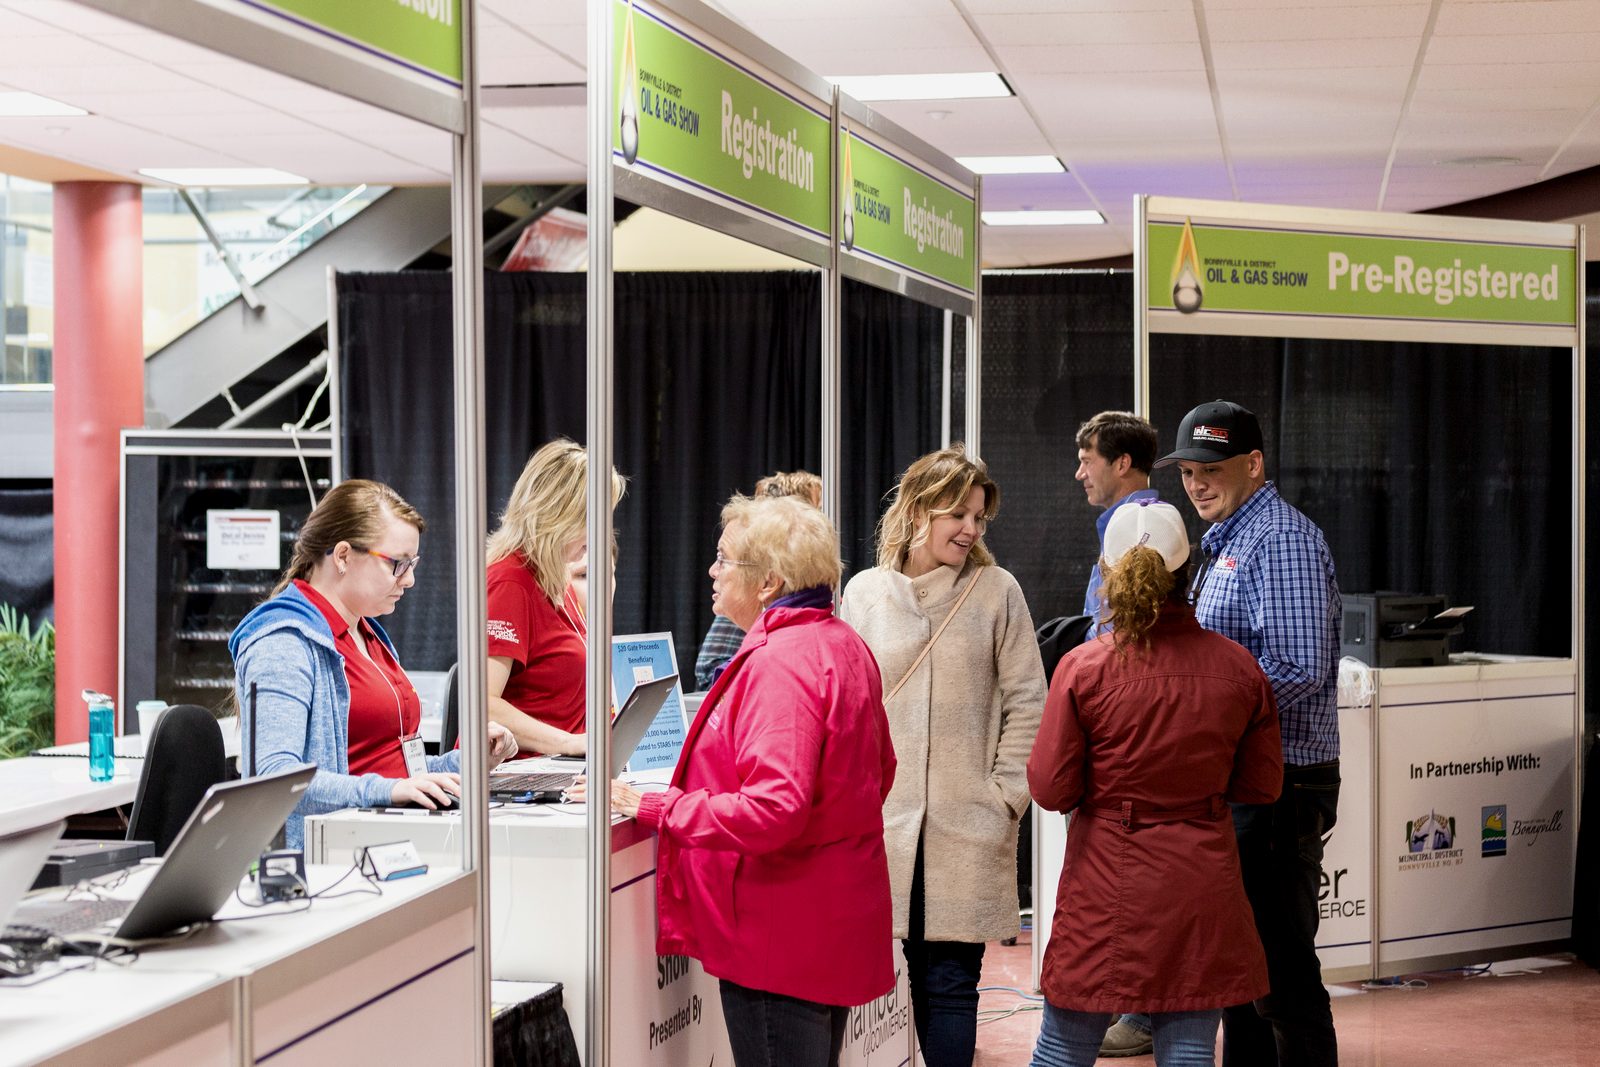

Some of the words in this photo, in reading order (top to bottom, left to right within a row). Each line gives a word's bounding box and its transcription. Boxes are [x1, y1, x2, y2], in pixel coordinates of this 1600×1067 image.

[641, 87, 653, 116] OIL
[655, 93, 661, 119] &
[662, 97, 677, 127] GAS
[679, 105, 700, 137] SHOW
[721, 89, 814, 193] Registration
[863, 196, 867, 215] &
[868, 197, 877, 220] GAS
[878, 202, 891, 225] SHOW
[903, 186, 964, 259] Registration
[1204, 258, 1242, 267] BONNYVILLE
[1249, 260, 1276, 268] DISTRICT
[1206, 267, 1227, 283] OIL
[1230, 269, 1240, 284] &
[1243, 269, 1268, 286] GAS
[1272, 271, 1308, 287] SHOW
[1328, 252, 1559, 305] Pre-Registered
[639, 643, 660, 651] Proceeds
[628, 656, 654, 664] Beneficiary
[660, 728, 669, 736] has
[668, 728, 681, 736] been
[657, 741, 671, 749] STARS
[671, 740, 683, 748] from
[1410, 763, 1423, 780] In
[1426, 756, 1504, 778] Partnership
[1506, 753, 1541, 771] With:
[1511, 809, 1564, 847] Bonnyville
[1398, 852, 1432, 863] MUNICIPAL
[1434, 849, 1463, 860] DISTRICT
[1319, 899, 1366, 919] ERCE
[649, 998, 691, 1051] Presented
[692, 994, 702, 1025] By
